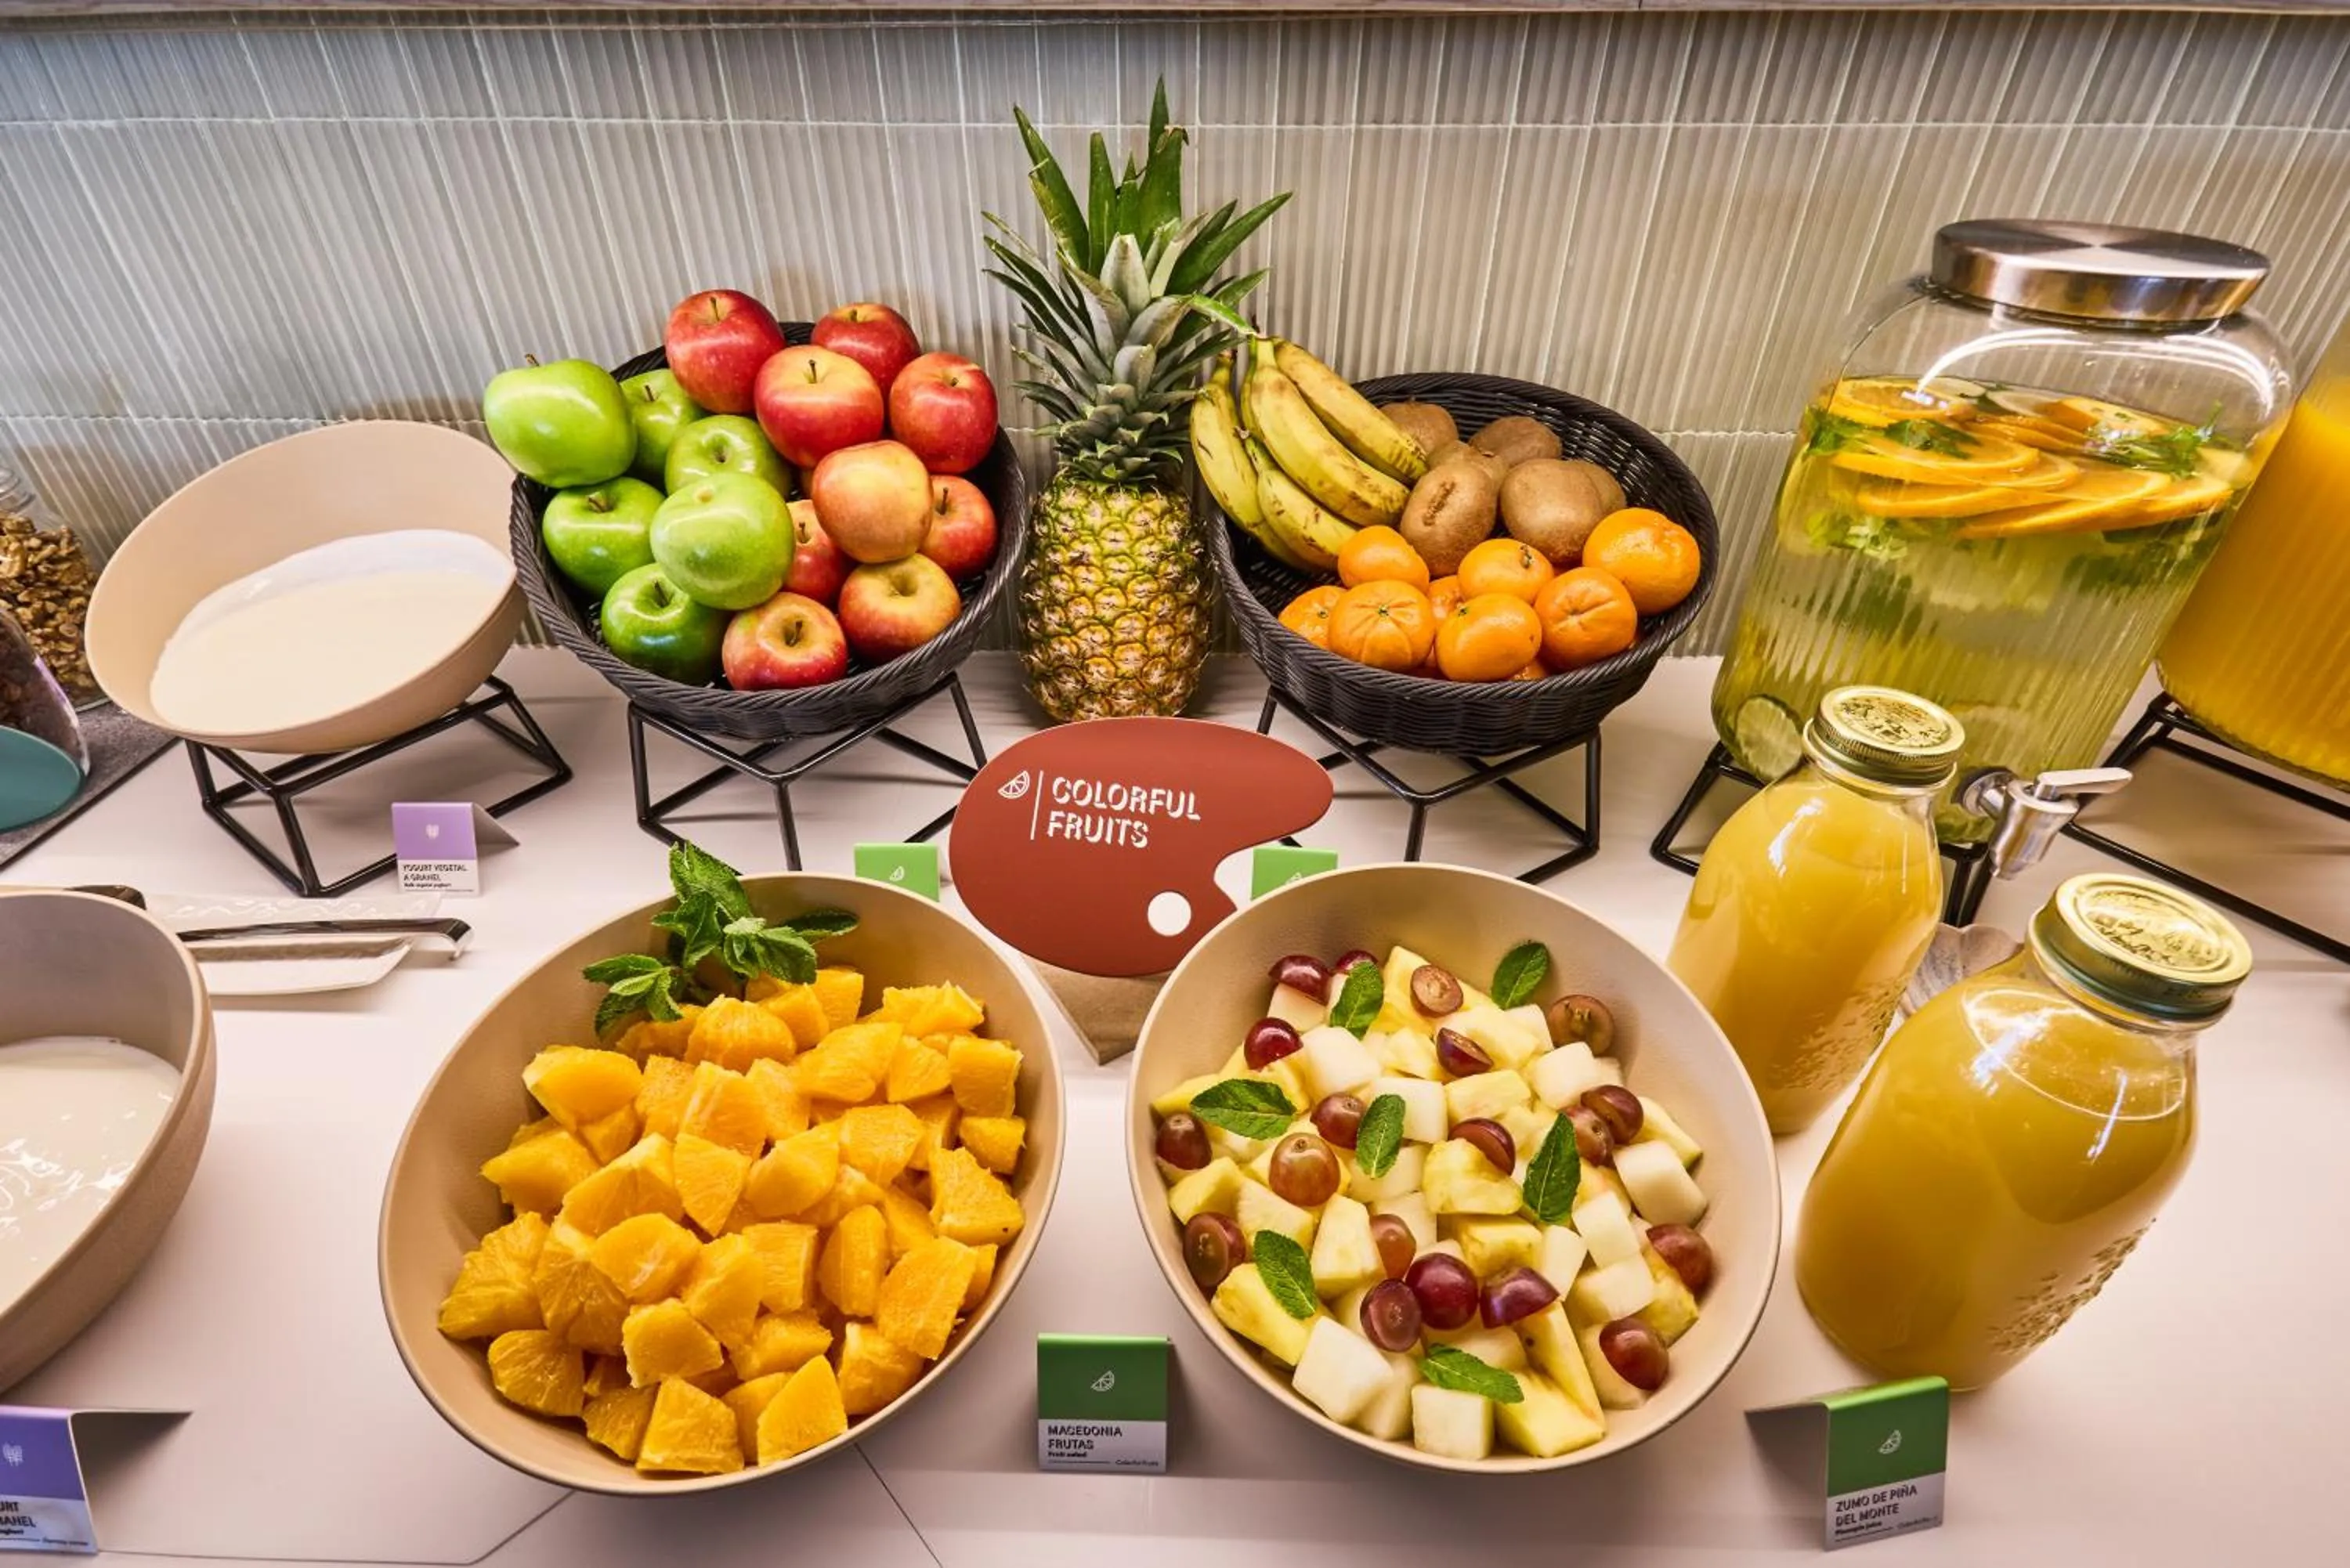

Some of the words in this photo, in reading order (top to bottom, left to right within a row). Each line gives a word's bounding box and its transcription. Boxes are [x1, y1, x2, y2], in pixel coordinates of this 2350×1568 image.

[1052, 777, 1201, 821] COLORFUL
[1047, 810, 1148, 848] FRUITS
[1048, 1425, 1123, 1437] MACEDONIA
[1048, 1439, 1094, 1450] FRUTAS
[1835, 1496, 1870, 1512] ZUMO
[1871, 1491, 1888, 1505] DE
[1889, 1484, 1918, 1500] PIÑA
[1835, 1513, 1857, 1526] DEL
[1859, 1503, 1900, 1521] MONTE
